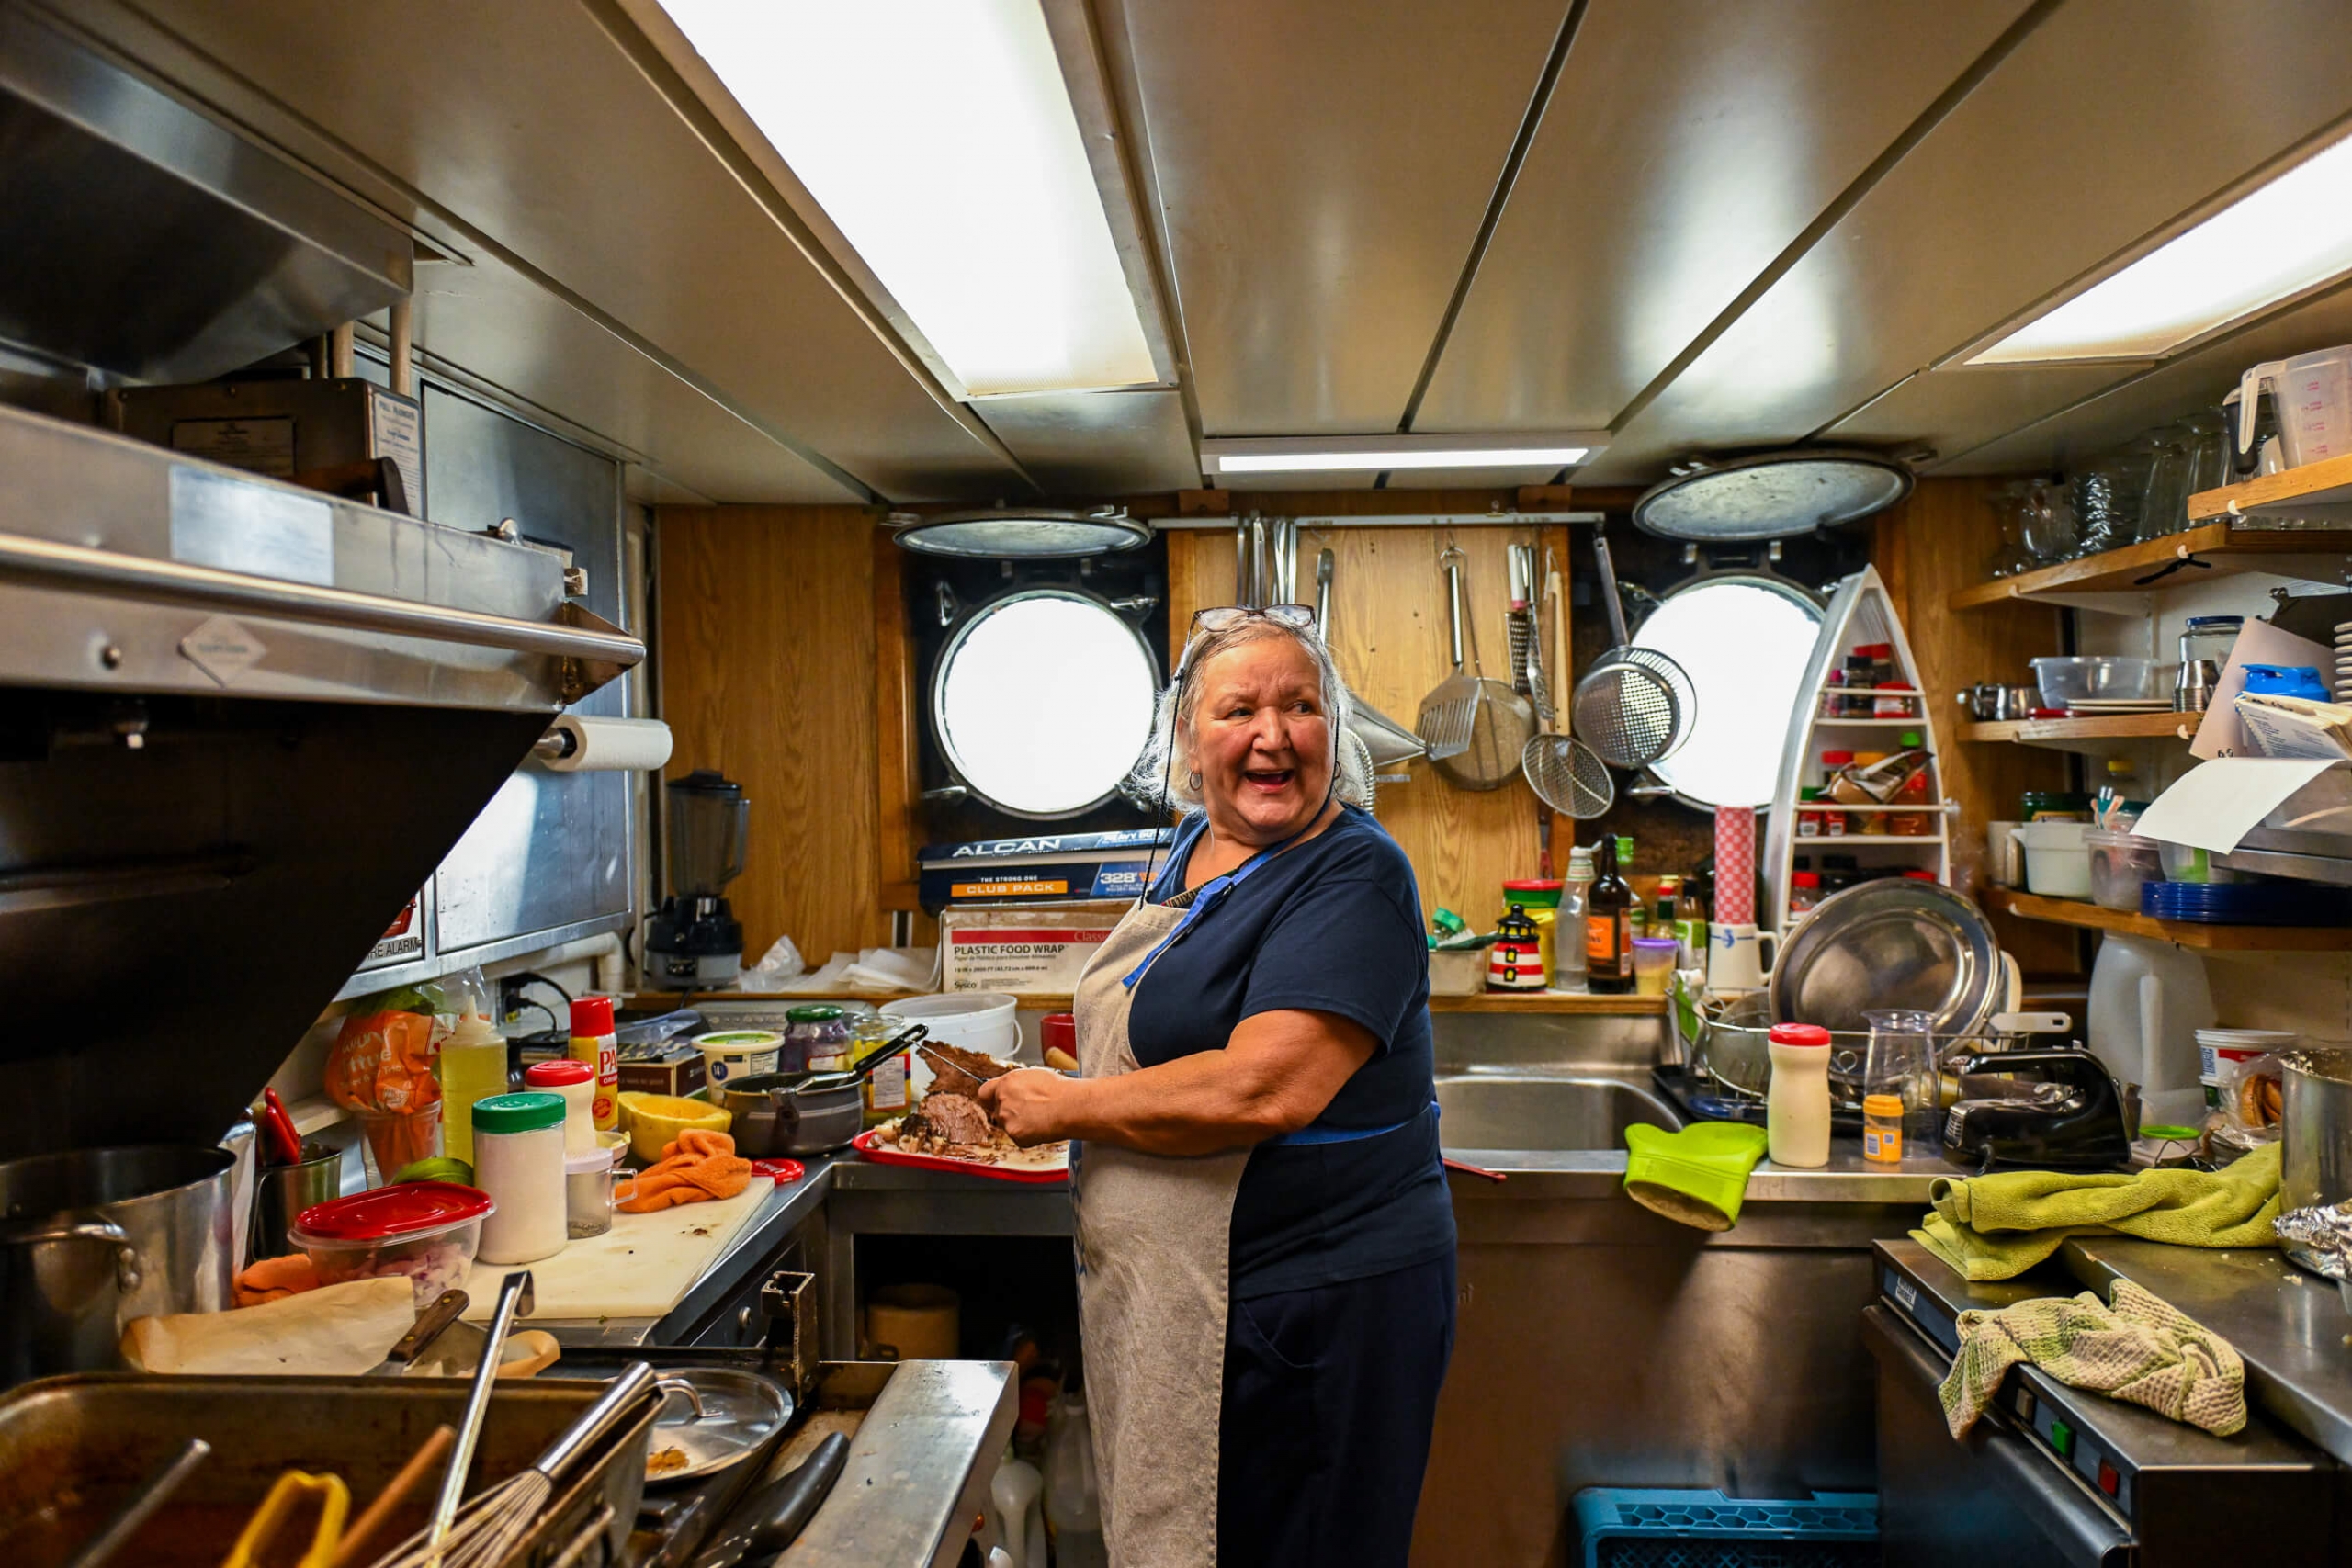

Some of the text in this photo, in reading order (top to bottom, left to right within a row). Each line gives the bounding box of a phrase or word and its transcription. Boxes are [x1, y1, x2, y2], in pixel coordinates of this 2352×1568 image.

[953, 839, 1060, 857] ALCAN
[967, 883, 1055, 894] CLUB PACK
[386, 938, 418, 955] ALARM
[954, 944, 1065, 955] PLASTIC FOOD WRAP
[955, 980, 977, 990] Sysco
[600, 1048, 617, 1074] PA
